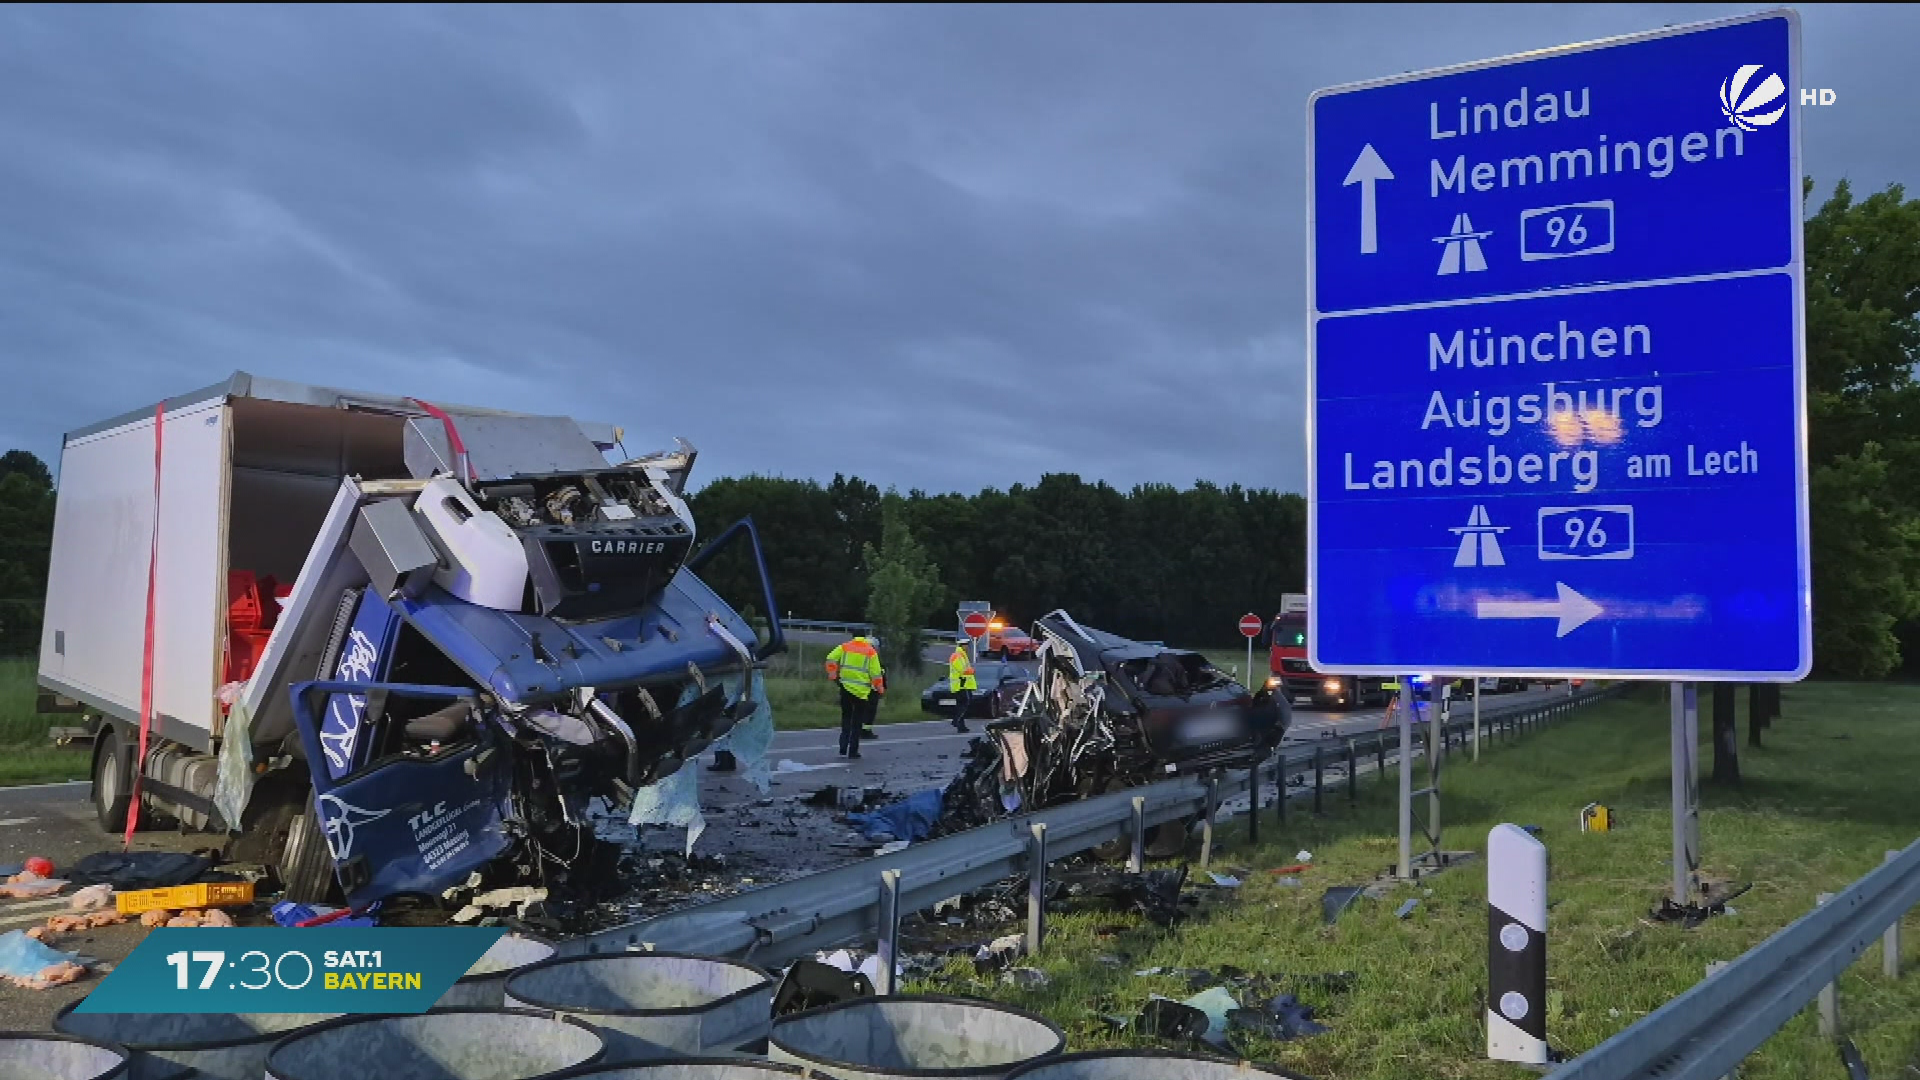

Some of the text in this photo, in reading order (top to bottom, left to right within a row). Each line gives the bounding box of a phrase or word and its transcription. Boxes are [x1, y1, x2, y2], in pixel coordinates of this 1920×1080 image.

[1430, 86, 1590, 140] Lindau
[1430, 126, 1744, 197] Memmingen
[1546, 214, 1588, 249] 96
[1429, 321, 1652, 371] München
[1421, 382, 1664, 436] Augsburg
[1345, 441, 1758, 493] Landsberg am Lech
[591, 540, 665, 554] CARRIER
[1565, 516, 1607, 548] 96
[408, 801, 446, 831] TLC
